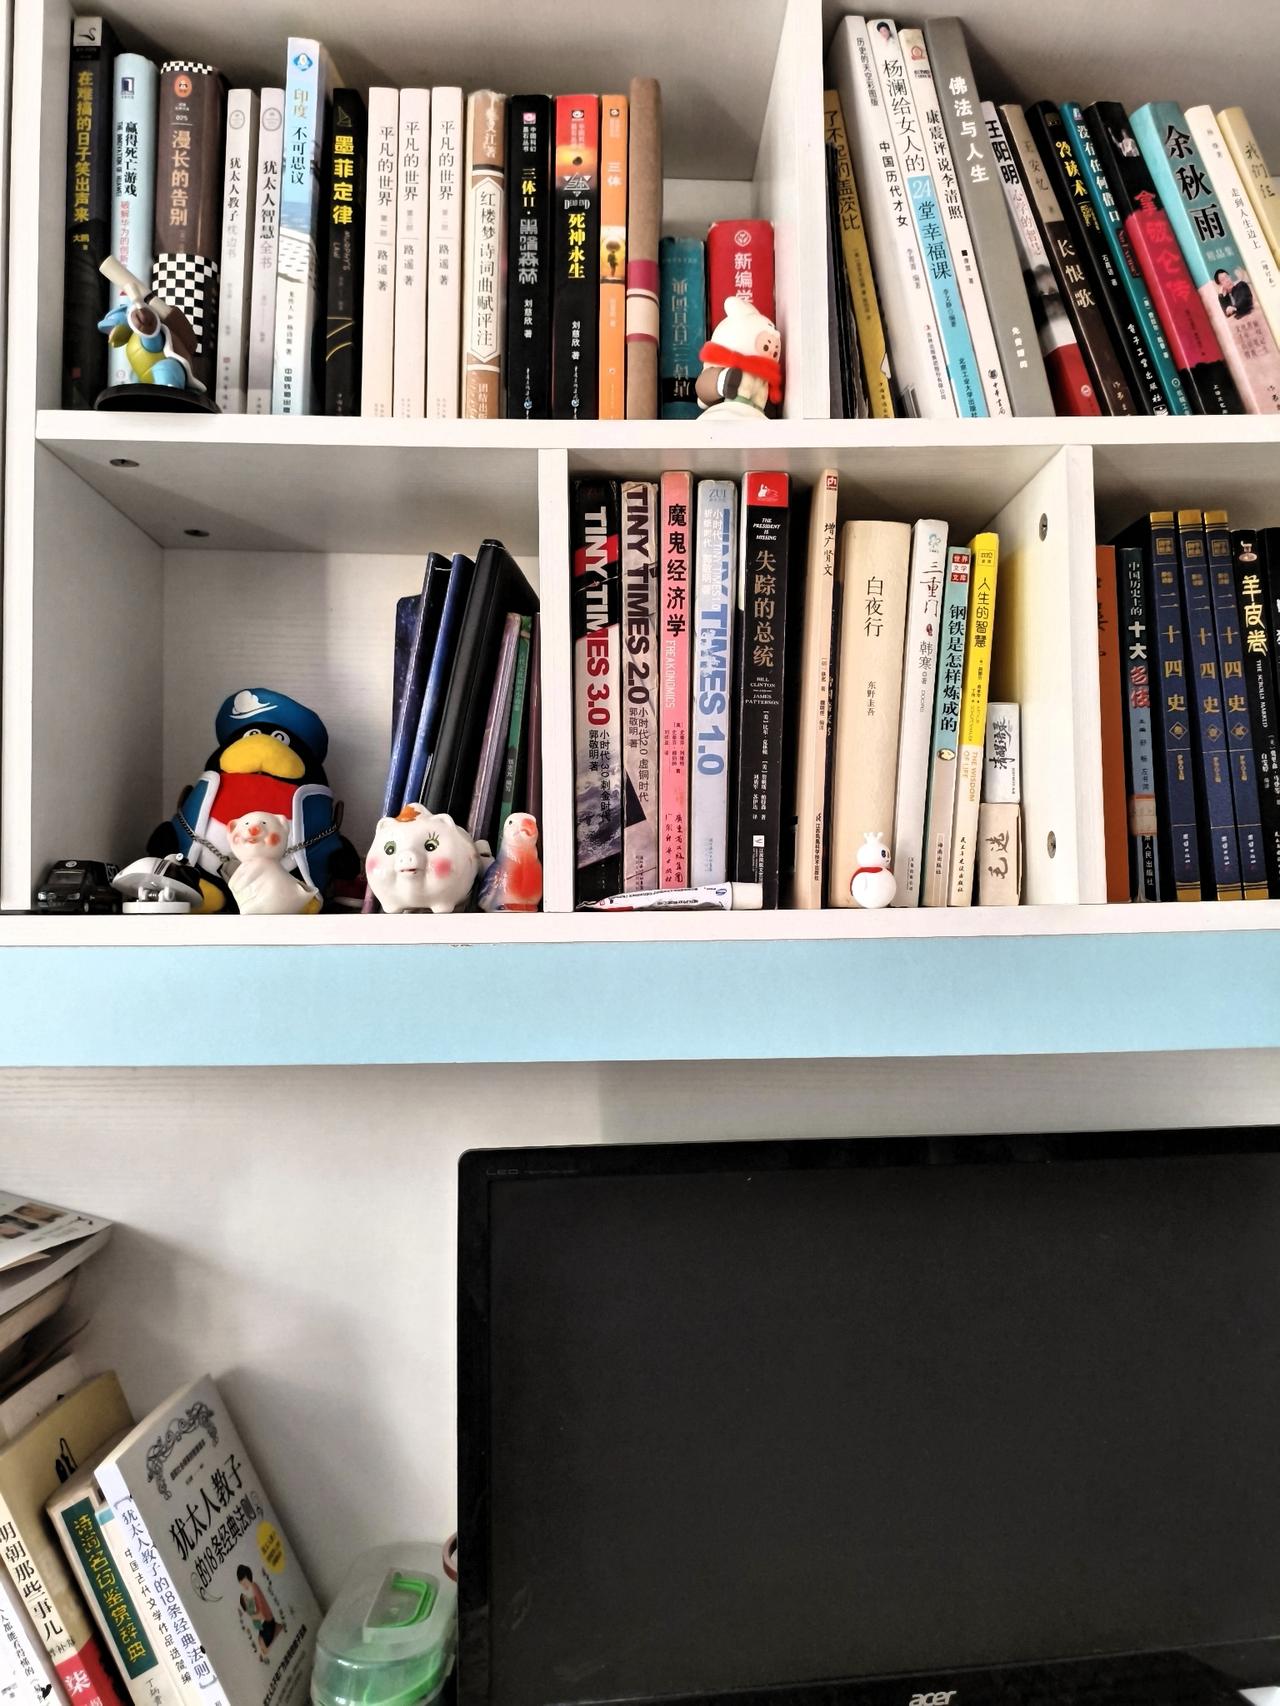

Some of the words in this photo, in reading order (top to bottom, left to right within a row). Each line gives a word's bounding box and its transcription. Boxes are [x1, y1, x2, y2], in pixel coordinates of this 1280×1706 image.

[74, 71, 93, 222] 在难搞的日子笑出声来
[124, 121, 138, 198] 赢得死亡游戏
[290, 130, 308, 189] 不可思议
[377, 125, 396, 207] 平凡的世界
[402, 121, 421, 202] 平凡的世界
[438, 120, 457, 202] 平凡的世界
[925, 109, 964, 220] 康震评说李清照
[949, 75, 990, 185] 佛法与人生
[985, 119, 1020, 186] 王阳明
[1056, 140, 1087, 197] 冷读术
[169, 130, 191, 227] 漫长的告别
[331, 135, 355, 225] 墨菲定律
[879, 143, 909, 228] 中国历代才女
[1076, 125, 1121, 223] 没有任何借口
[1165, 123, 1226, 243] 余秋雨
[1245, 142, 1276, 200] 我们仨
[568, 213, 587, 279] 死神永生
[1134, 189, 1191, 305] 拿破仑传
[1231, 187, 1262, 251] 走到人生边上
[477, 190, 497, 348] 红楼梦诗词曲赋评注
[1056, 243, 1096, 309] 长恨歌
[584, 505, 607, 579] TINY
[626, 485, 649, 558] TINY
[822, 521, 836, 577] 增广贤文
[952, 553, 970, 564] 世界
[667, 503, 687, 637] 魔鬼经济学
[864, 575, 886, 638] 白夜行
[920, 561, 944, 618] 三重门
[951, 563, 969, 574] 文学
[1128, 560, 1143, 616] 中国历史上的
[585, 583, 610, 678] TIMES
[627, 562, 651, 656] TIMES
[752, 549, 778, 666] 失踪的总统
[974, 576, 992, 648] 人生的智慧
[1128, 620, 1148, 661] 十大
[1241, 574, 1268, 657] 羊皮卷
[627, 660, 652, 706] 2.0
[700, 603, 728, 716] TIMES
[919, 642, 934, 671] 韩寒
[940, 603, 968, 734] 钢铁是怎样炼成的
[1160, 592, 1189, 712] 二十四史
[1192, 594, 1221, 714] 二十四史
[1217, 593, 1246, 713] 二十四史
[587, 682, 611, 726] 3.0
[629, 711, 639, 740] 郭敬明
[638, 711, 650, 760] 小时代2.0
[866, 680, 877, 717] 东野圭吾
[589, 732, 600, 764] 郭敬明
[638, 762, 650, 803] 虚铜时代
[697, 724, 727, 776] 1.0
[168, 1453, 244, 1562] 犹太人教子
[194, 1493, 259, 1588] 的18条经典法则
[0, 1521, 64, 1641] 明朝那些事儿
[124, 1546, 193, 1687] 中国古代文学作品选简编
[908, 1690, 957, 1706] acer
